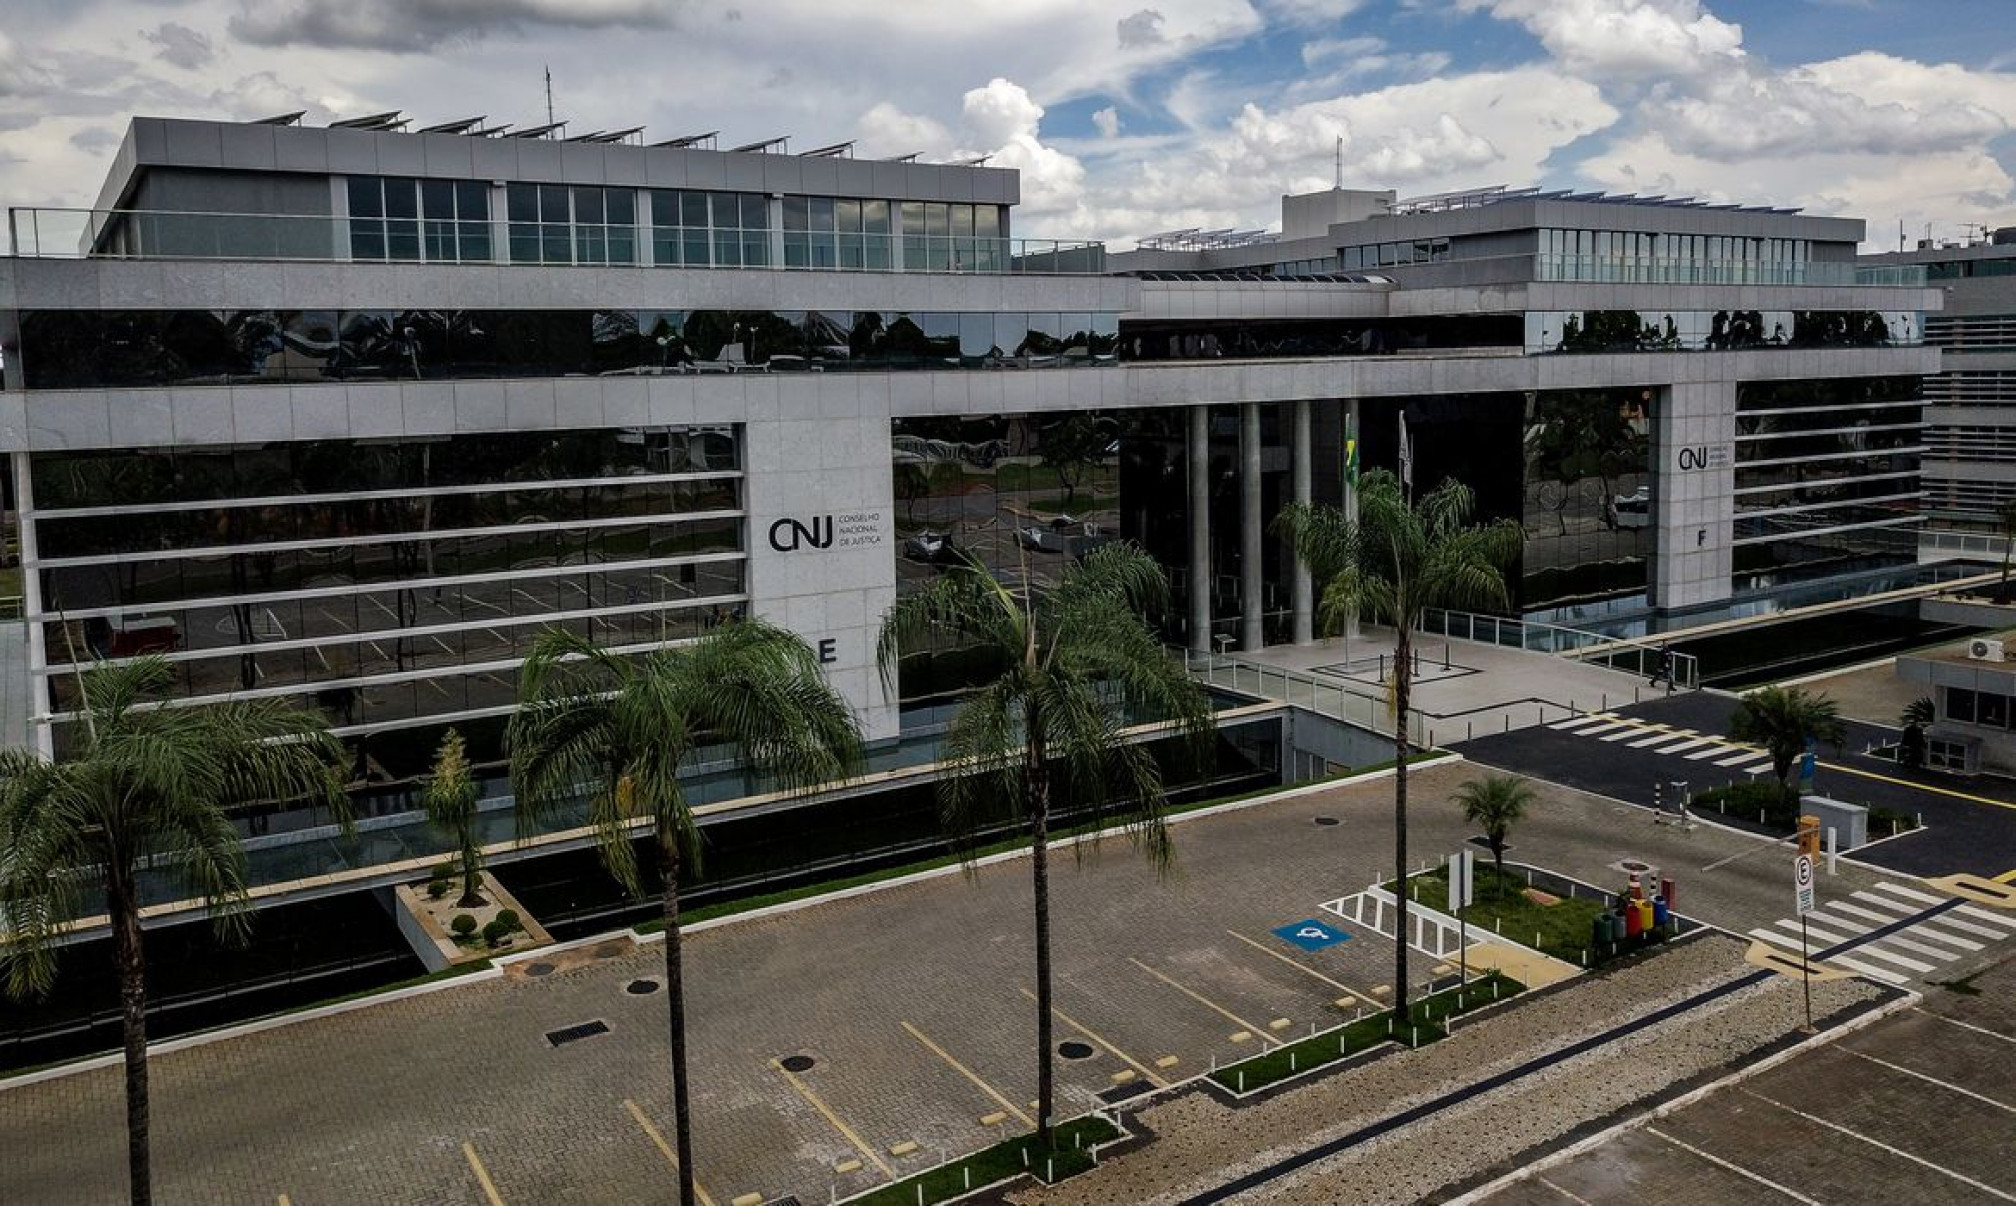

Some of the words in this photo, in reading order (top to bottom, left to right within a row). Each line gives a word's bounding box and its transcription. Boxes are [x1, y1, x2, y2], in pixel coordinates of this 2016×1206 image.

[1680, 446, 1707, 470] CNJ
[839, 513, 880, 523] CONSELHO
[769, 515, 833, 551] CNJ
[839, 525, 878, 534] NACIONAL
[1698, 530, 1706, 546] F
[818, 638, 837, 663] E
[1800, 862, 1807, 880] E
